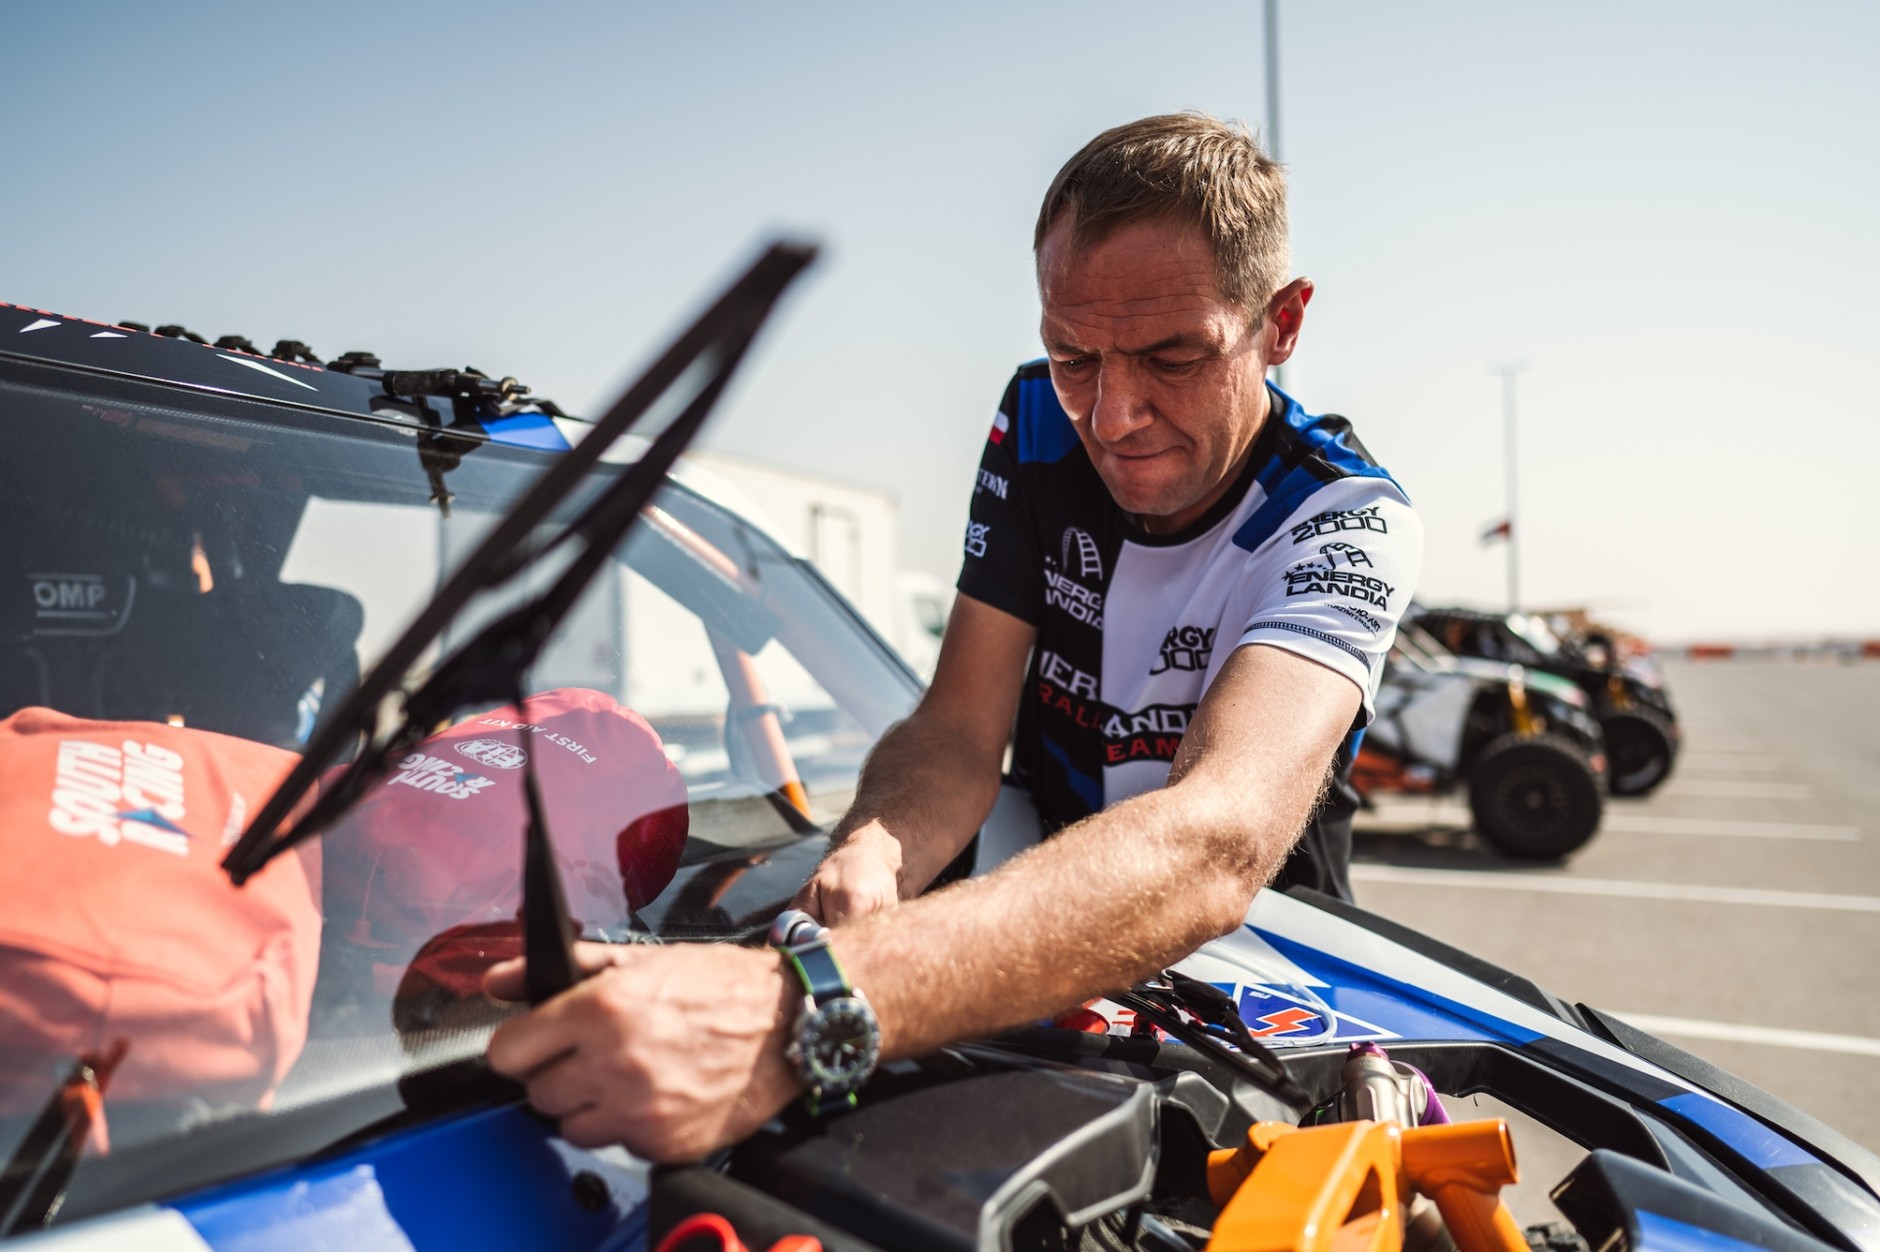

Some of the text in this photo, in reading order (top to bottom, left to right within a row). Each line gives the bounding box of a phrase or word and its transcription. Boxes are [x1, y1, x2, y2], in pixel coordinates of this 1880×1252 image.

[967, 520, 991, 541] GY
[1292, 515, 1388, 545] 2000
[33, 581, 105, 608] OMP
[1286, 582, 1388, 612] LANDIA
[1288, 570, 1395, 597] ENERGY
[479, 717, 512, 727] KIT
[1103, 707, 1195, 738] AND
[545, 733, 597, 764] FIRST
[1104, 737, 1181, 762] EAM
[49, 740, 124, 848] SOUTH
[387, 770, 482, 799] SOUTH
